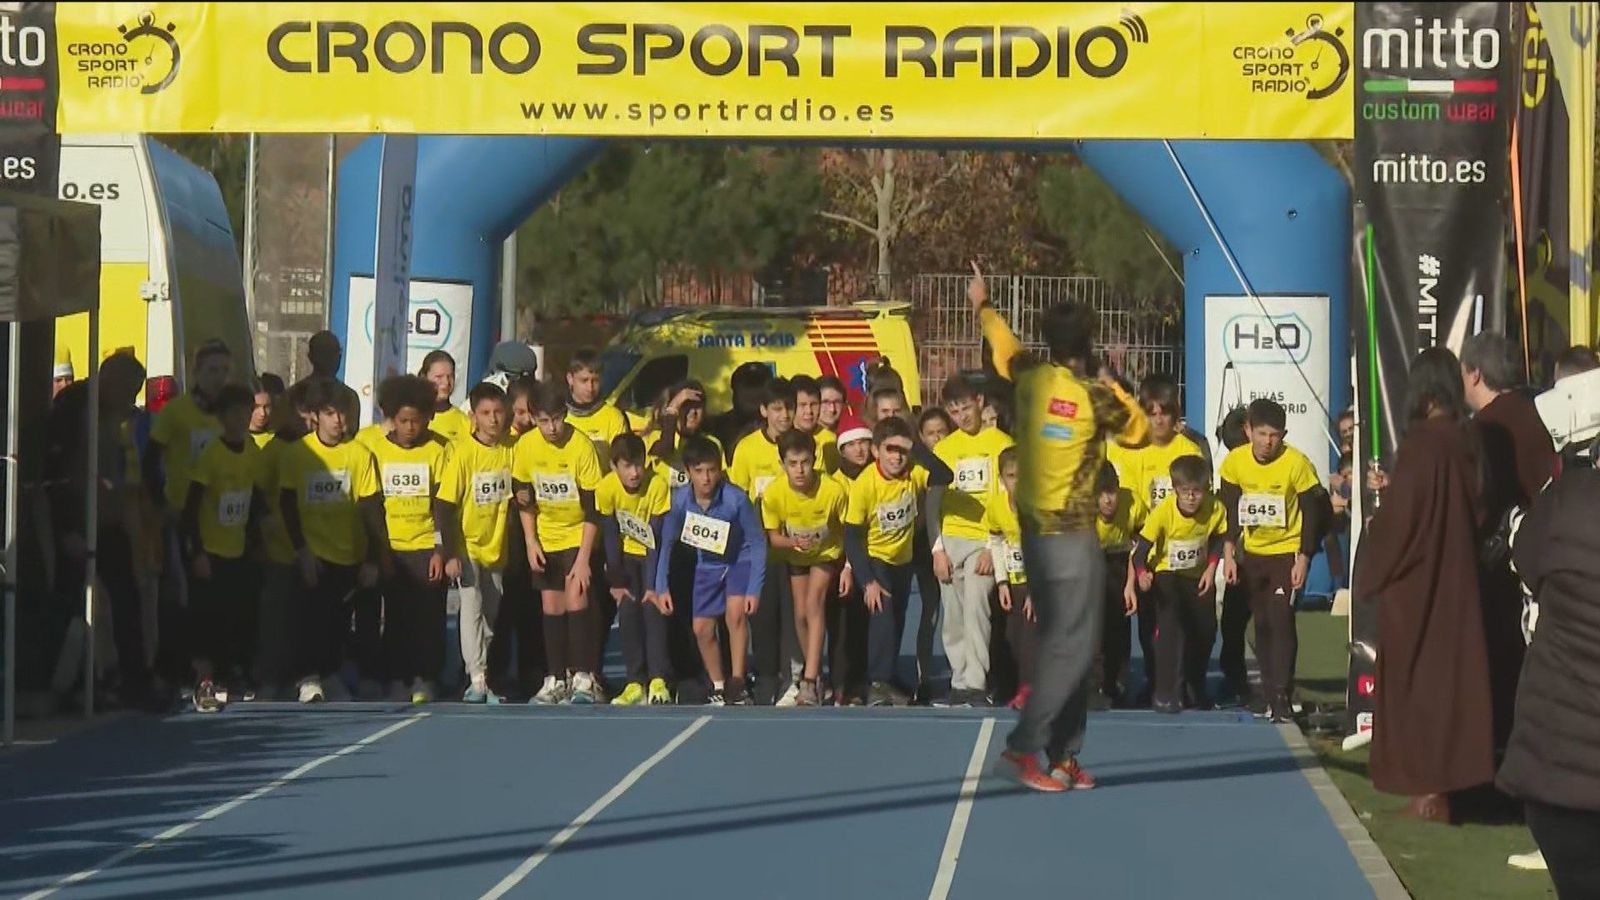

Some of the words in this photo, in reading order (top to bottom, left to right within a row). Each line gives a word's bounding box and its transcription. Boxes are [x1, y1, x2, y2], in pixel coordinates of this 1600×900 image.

[0, 15, 46, 67] to
[1363, 18, 1500, 69] mitto
[67, 43, 128, 56] CRONO
[266, 21, 541, 74] CRONO
[576, 23, 852, 76] SPORT
[884, 25, 1128, 79] RADIO
[1233, 46, 1295, 60] CRONO
[78, 60, 139, 72] SPORT
[1242, 63, 1304, 76] SPORT
[88, 76, 140, 88] RADIO
[1252, 80, 1306, 93] RADIO
[519, 97, 895, 127] www.sportradio.es
[1363, 99, 1440, 120] custom
[1446, 102, 1497, 120] wear
[0, 156, 36, 180] es
[1372, 153, 1487, 183] mitto.es
[62, 182, 120, 200] o.es
[1418, 254, 1441, 354] #MIT
[1234, 323, 1301, 350] H2O
[1249, 391, 1285, 401] RIVAS
[391, 474, 421, 487] 638
[959, 468, 985, 482] 631
[314, 480, 343, 494] 607
[1247, 502, 1277, 517] 645
[691, 523, 720, 542] 604
